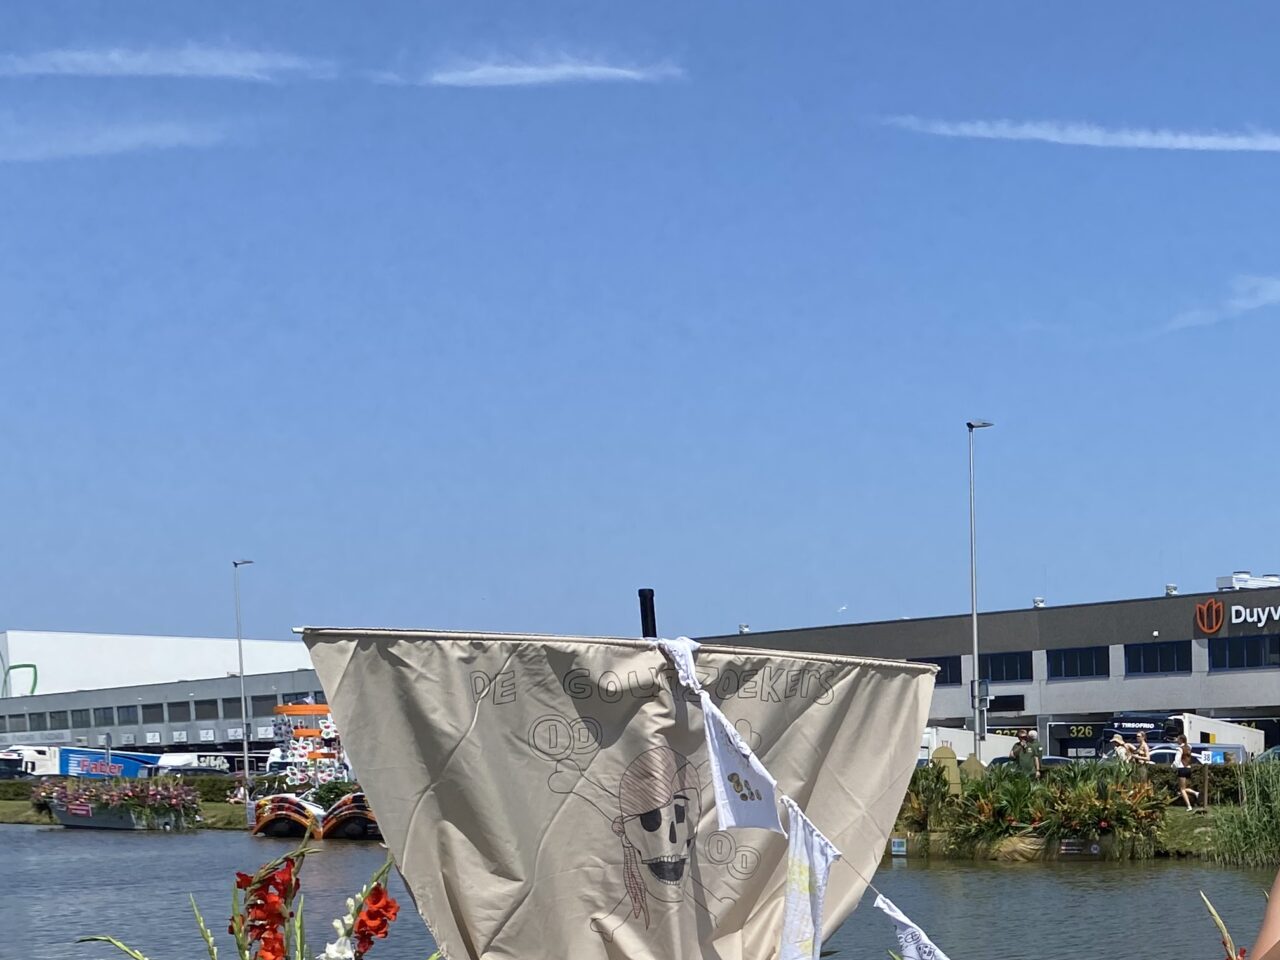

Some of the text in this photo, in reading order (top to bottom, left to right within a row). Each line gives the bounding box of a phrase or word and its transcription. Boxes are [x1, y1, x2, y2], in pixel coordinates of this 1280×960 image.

[470, 668, 517, 705] DE
[1069, 726, 1093, 738] 326
[1203, 753, 1211, 762] 38
[80, 758, 124, 776] Faber
